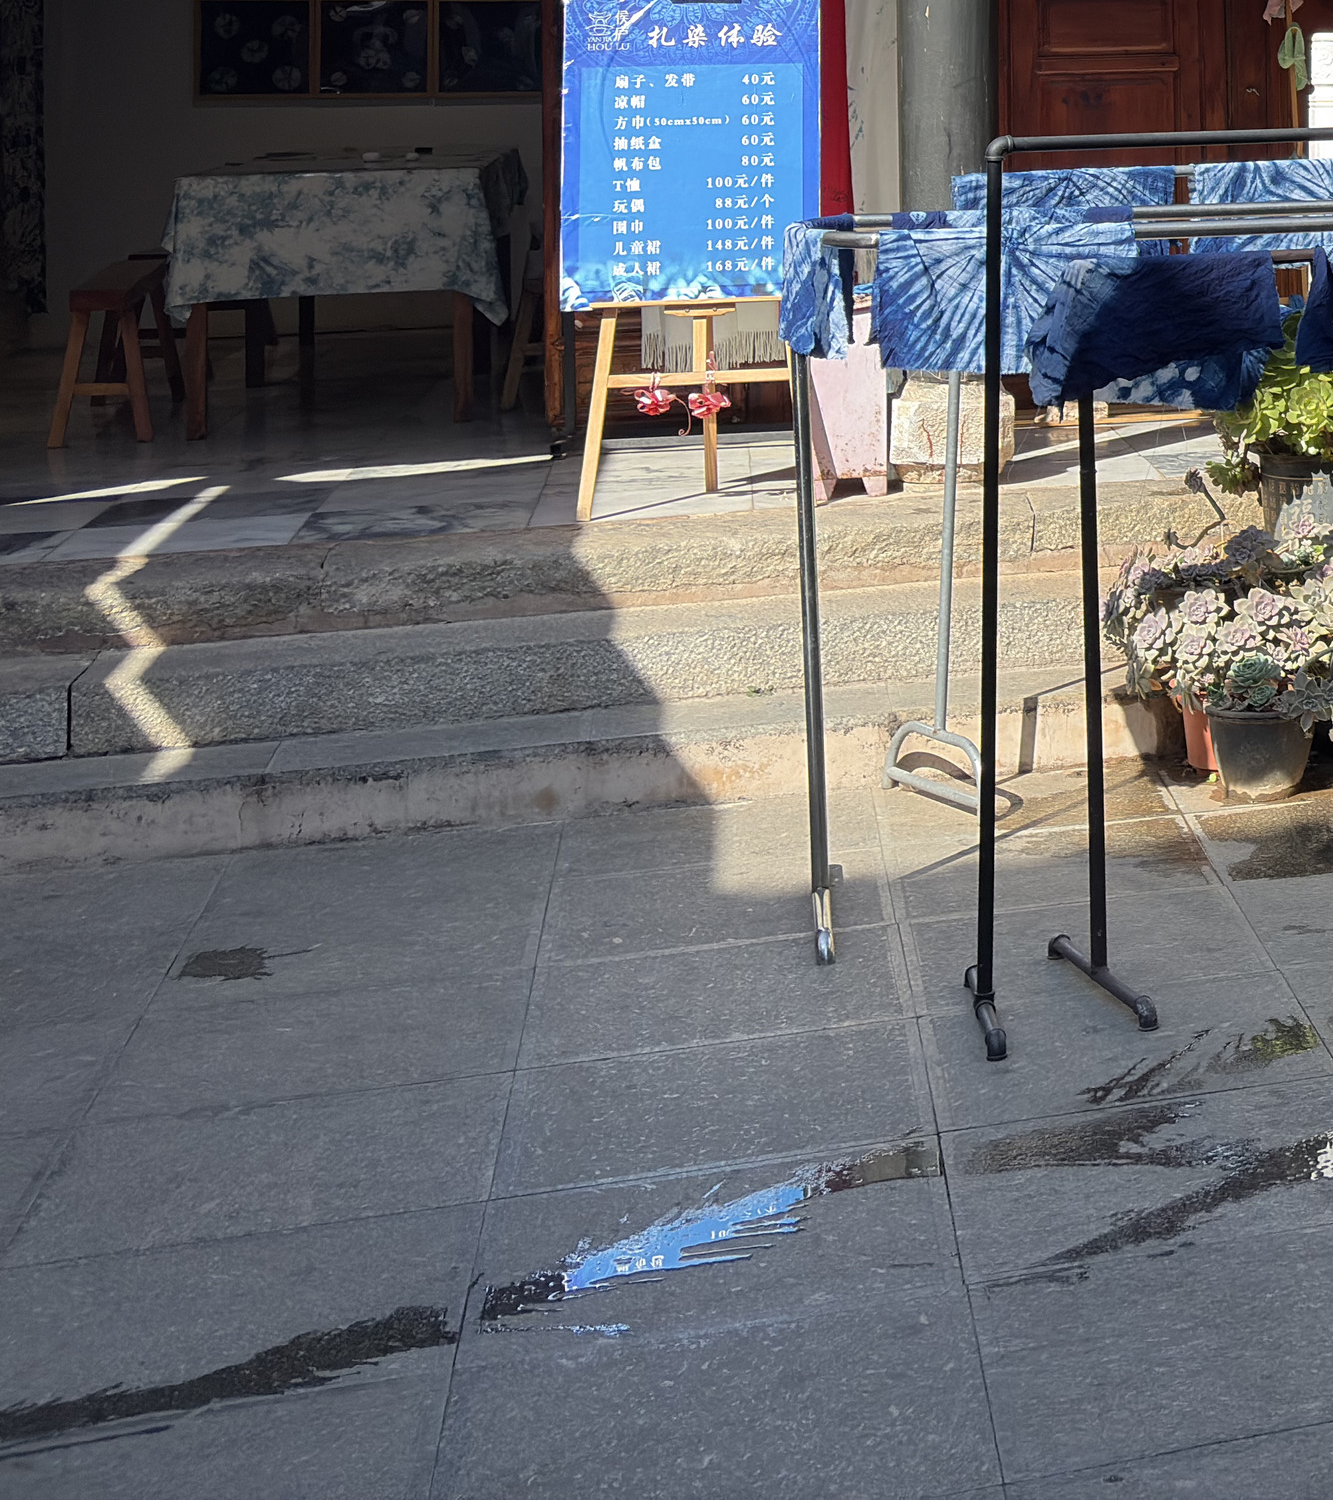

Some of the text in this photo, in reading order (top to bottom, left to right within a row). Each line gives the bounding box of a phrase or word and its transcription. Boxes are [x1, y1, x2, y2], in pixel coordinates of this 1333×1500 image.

[647, 23, 783, 48] 扎染体验
[587, 43, 630, 51] HOU LU
[741, 72, 776, 86] 40元
[614, 92, 776, 110] 凉帽 60元
[741, 112, 776, 126] 60元
[613, 133, 776, 151] 抽纸盒 60元
[613, 153, 776, 172] 帆布包 80元
[612, 174, 776, 193] T恤 100元/件
[612, 194, 776, 213] 玩偶 88元/个
[612, 215, 776, 235] 围巾 100元/件
[612, 236, 776, 257] 儿童裙 148元/件
[612, 256, 776, 277] 成人裙 168元/件
